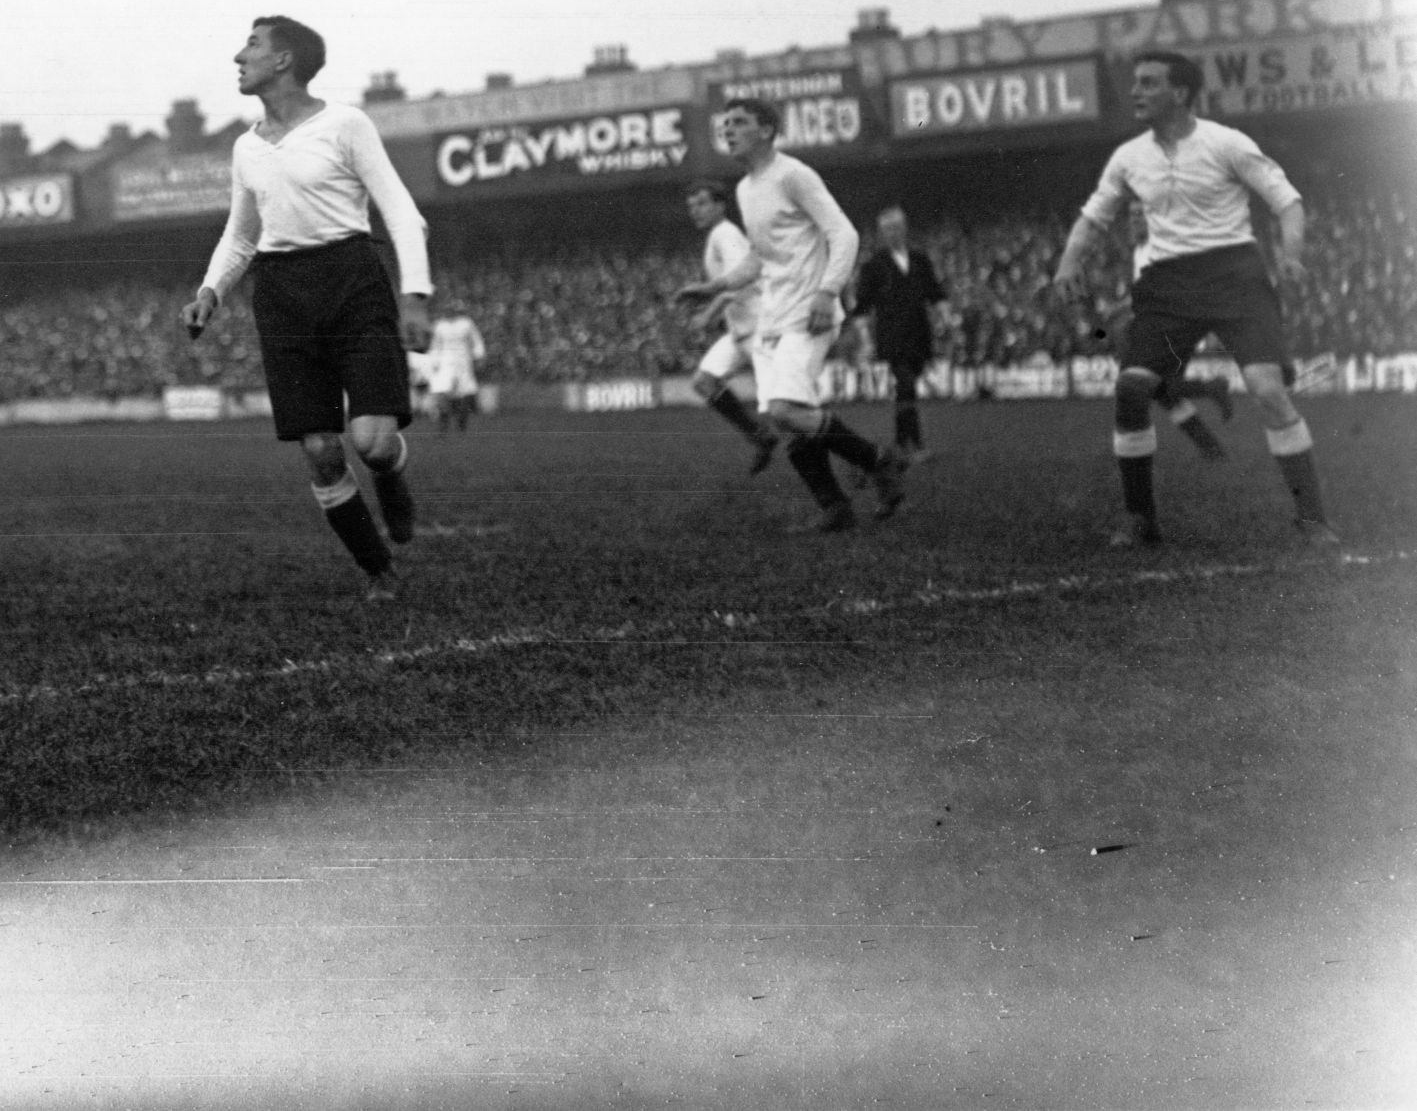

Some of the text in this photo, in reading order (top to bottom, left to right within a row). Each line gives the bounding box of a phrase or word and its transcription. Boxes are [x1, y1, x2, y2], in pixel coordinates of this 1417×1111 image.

[906, 71, 1083, 129] BOVRIL
[1244, 78, 1381, 111] FOOTBALL
[437, 109, 683, 186] CLAYMORE
[578, 141, 688, 174] WHISKY
